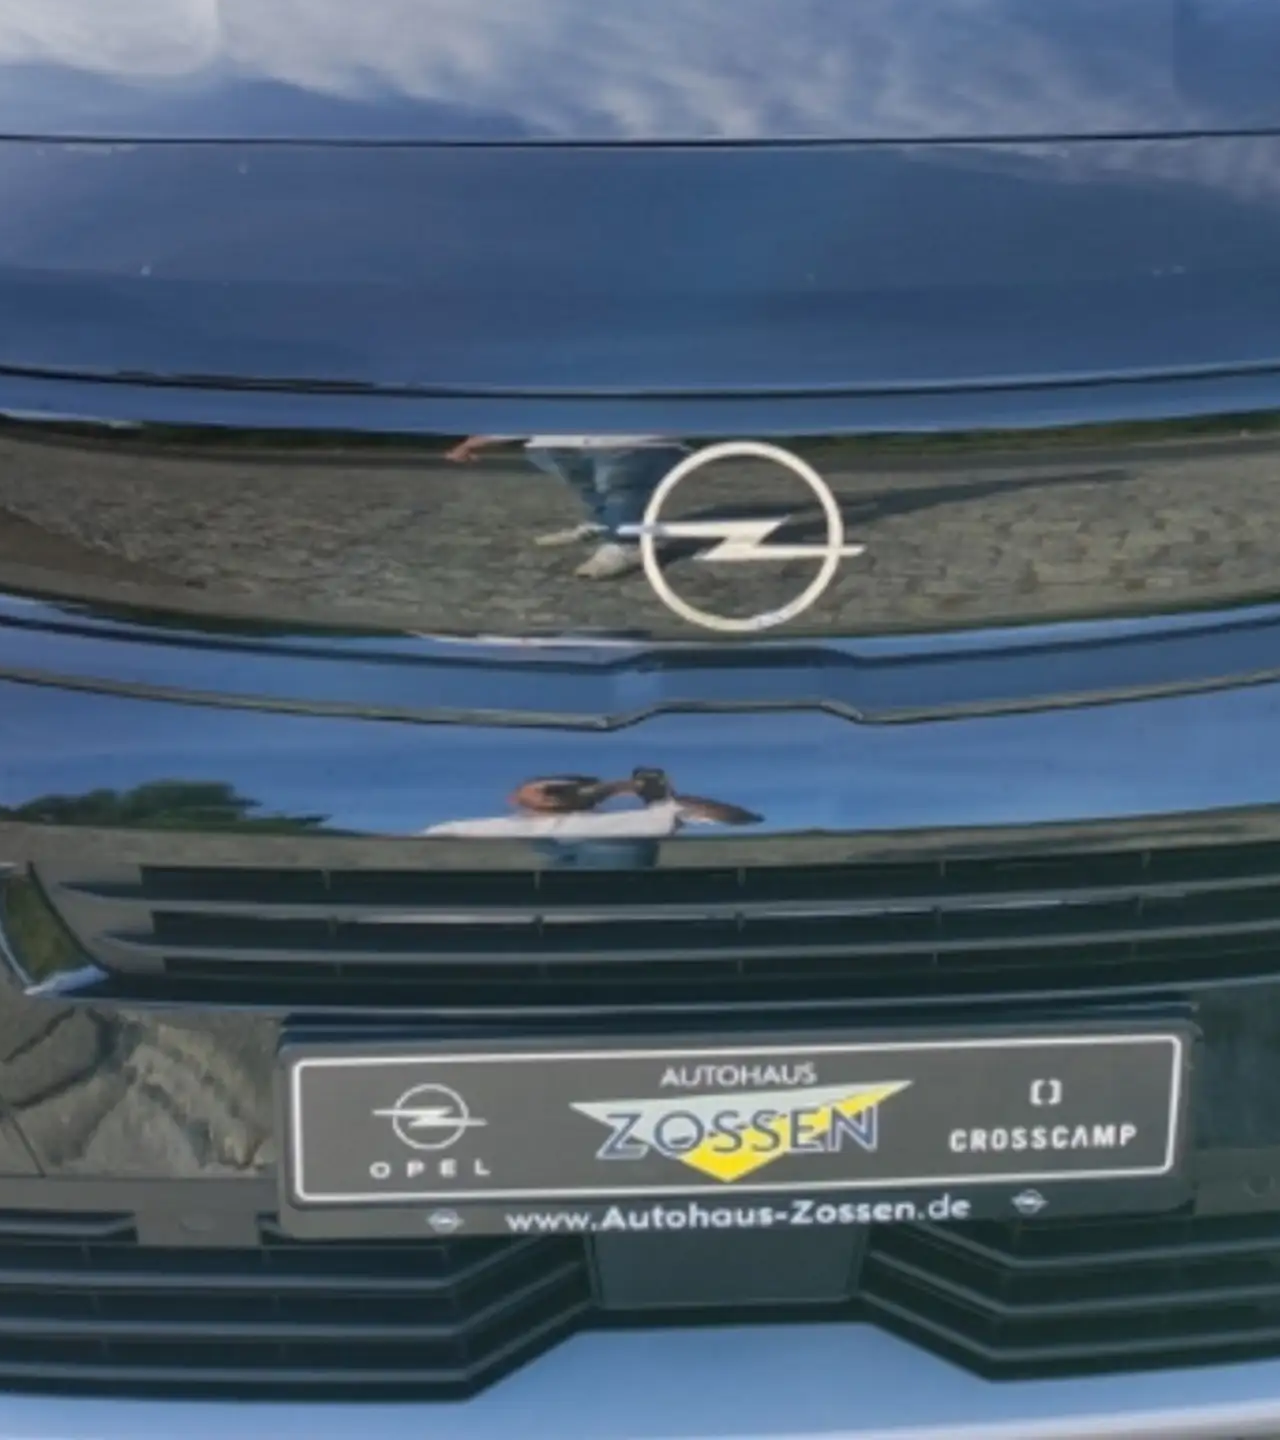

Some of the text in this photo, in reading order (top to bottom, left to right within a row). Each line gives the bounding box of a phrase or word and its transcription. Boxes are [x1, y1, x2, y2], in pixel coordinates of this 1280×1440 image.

[659, 1061, 817, 1090] AUTOHAUS
[596, 1100, 879, 1162] ZOSSEN
[949, 1122, 1137, 1153] CROSSCAMP
[368, 1157, 492, 1180] OPEL
[505, 1193, 972, 1234] www.Autohaus-Zossen.de
